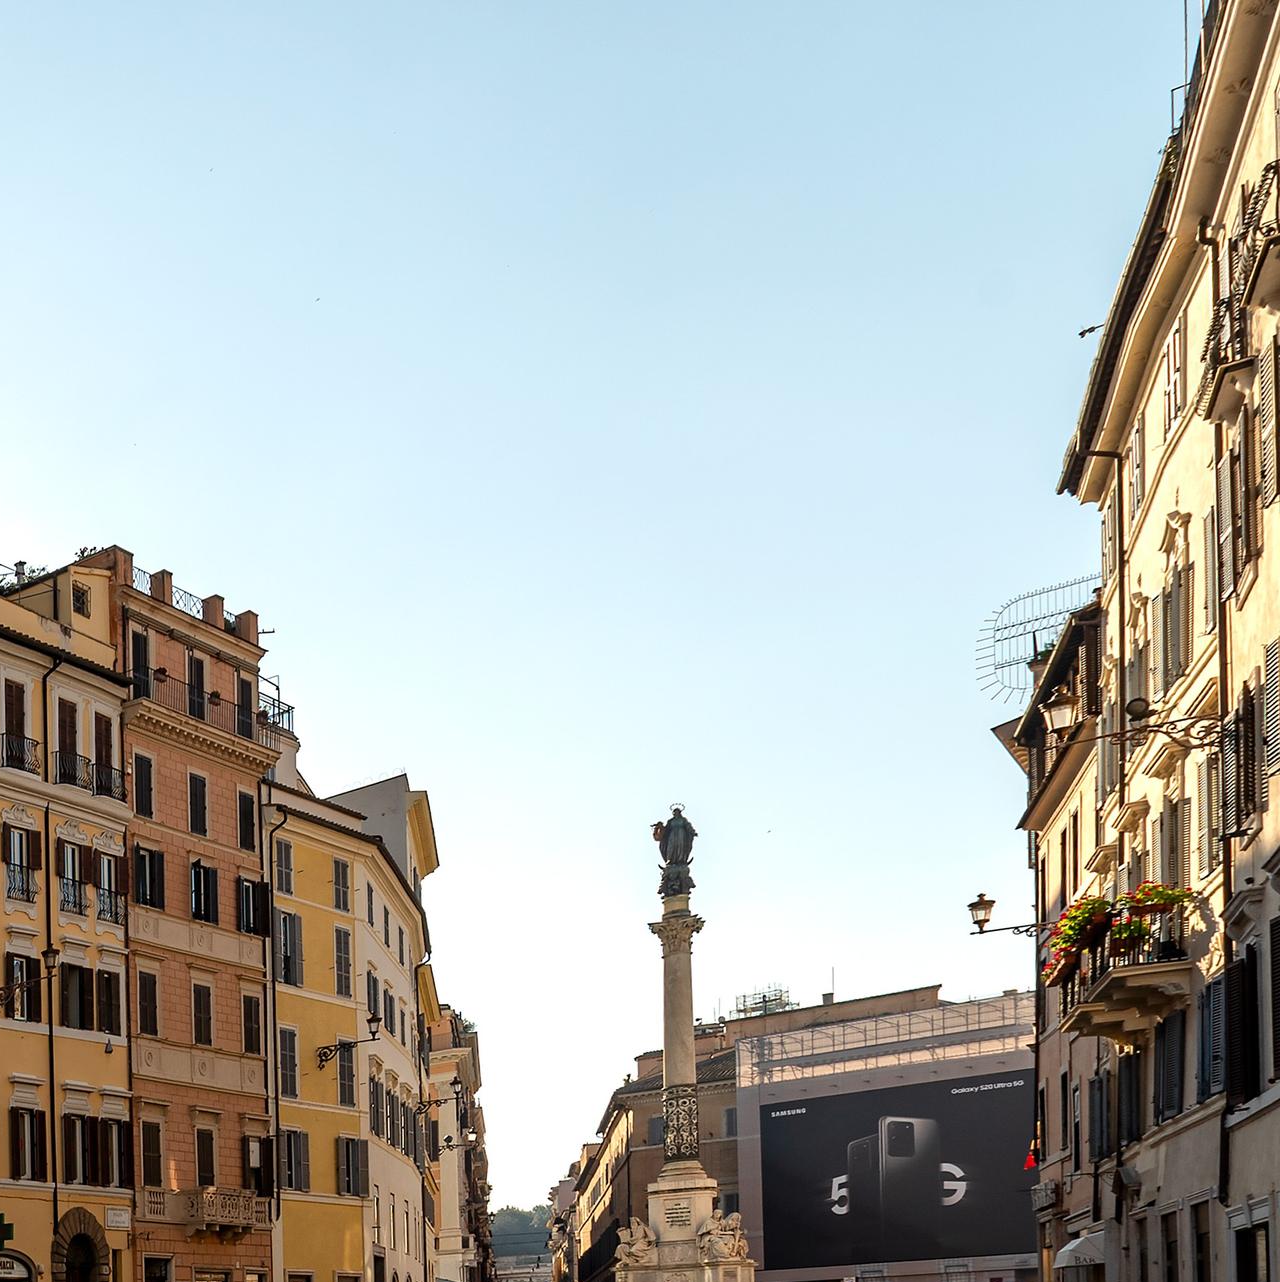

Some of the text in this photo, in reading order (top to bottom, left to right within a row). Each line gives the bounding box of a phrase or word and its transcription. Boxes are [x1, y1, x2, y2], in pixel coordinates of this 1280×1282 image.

[951, 1086, 979, 1094] Galaxy
[980, 1083, 993, 1091] S20
[994, 1081, 1012, 1089] Ultra
[771, 1107, 806, 1118] SAMSUNG
